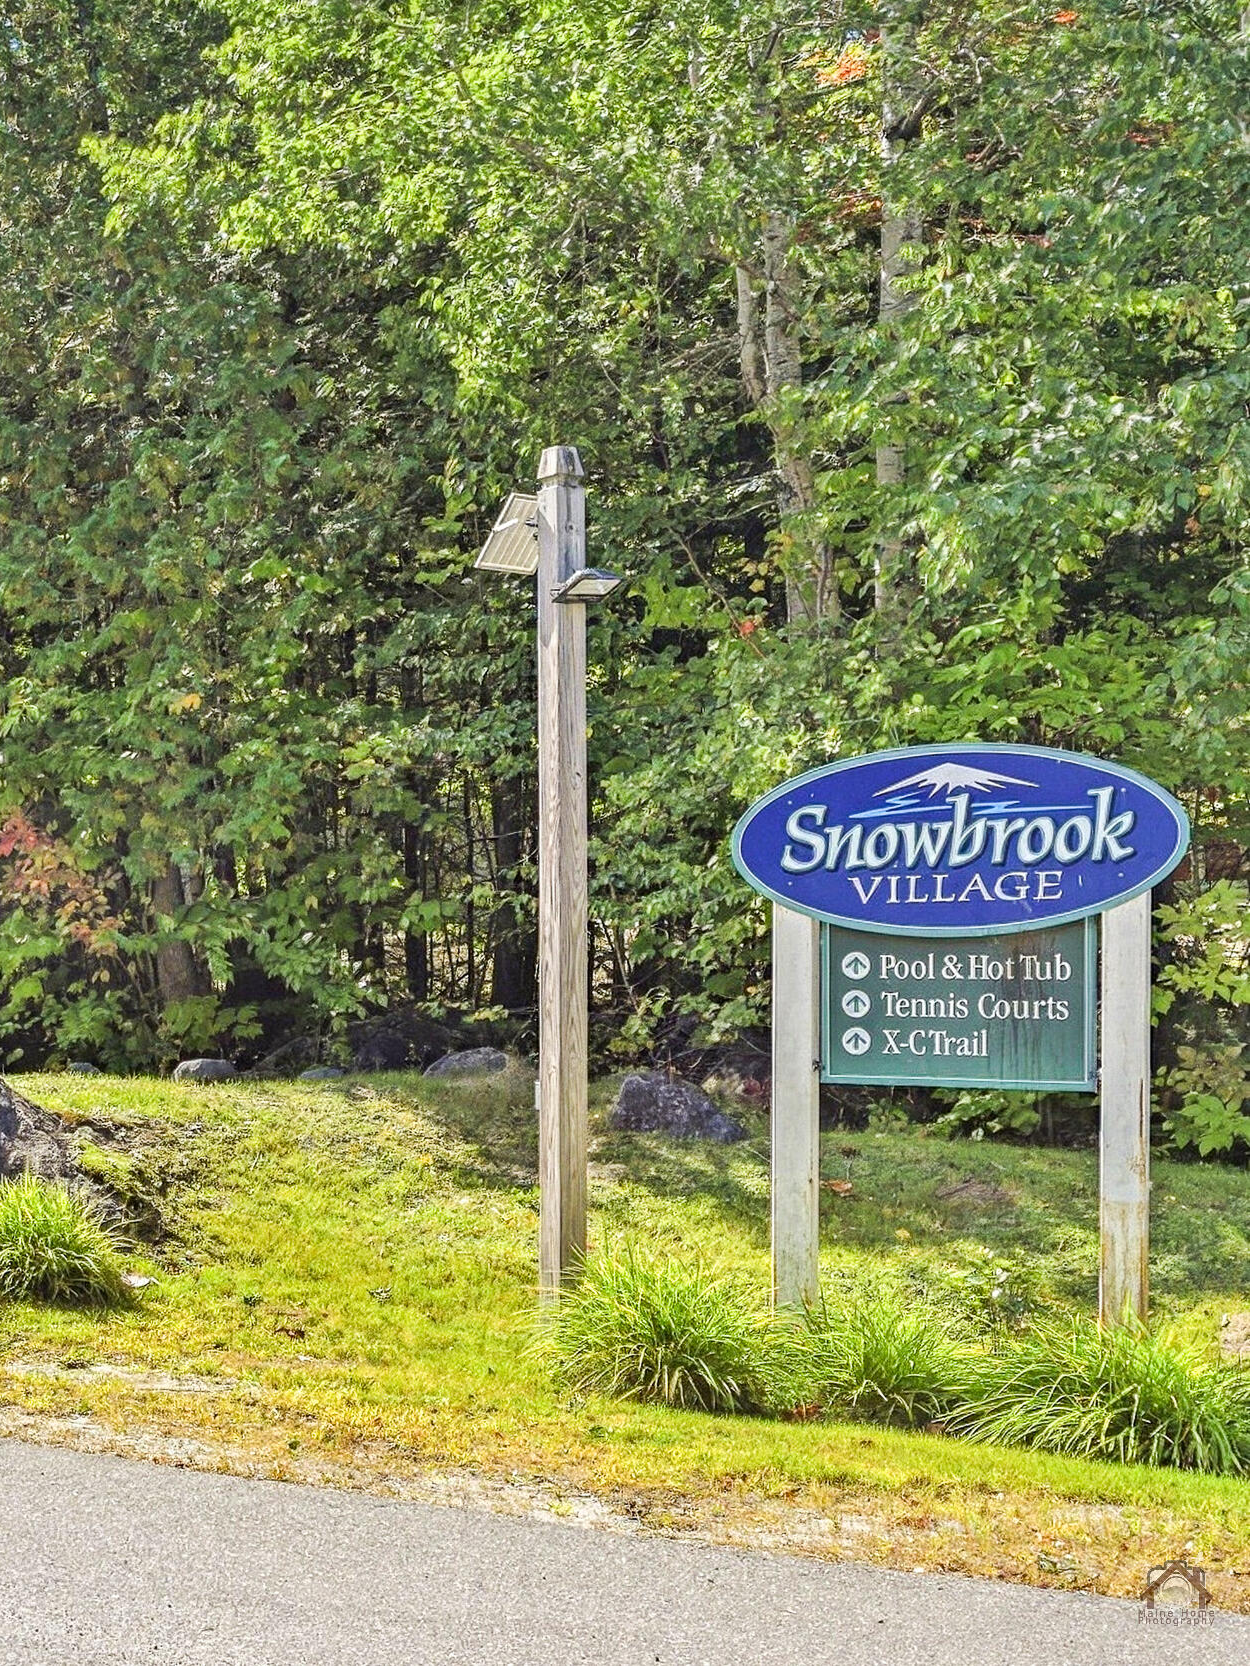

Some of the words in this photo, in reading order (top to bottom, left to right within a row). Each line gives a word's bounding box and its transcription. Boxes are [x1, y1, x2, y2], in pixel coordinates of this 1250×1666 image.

[781, 786, 1137, 873] Snowbrook
[848, 871, 1064, 905] VILLAGE
[879, 954, 936, 981] Pool
[941, 955, 964, 980] &
[968, 956, 1015, 981] Hot
[1018, 954, 1072, 982] Tub
[882, 991, 969, 1019] Tennis
[978, 993, 1070, 1021] Courts
